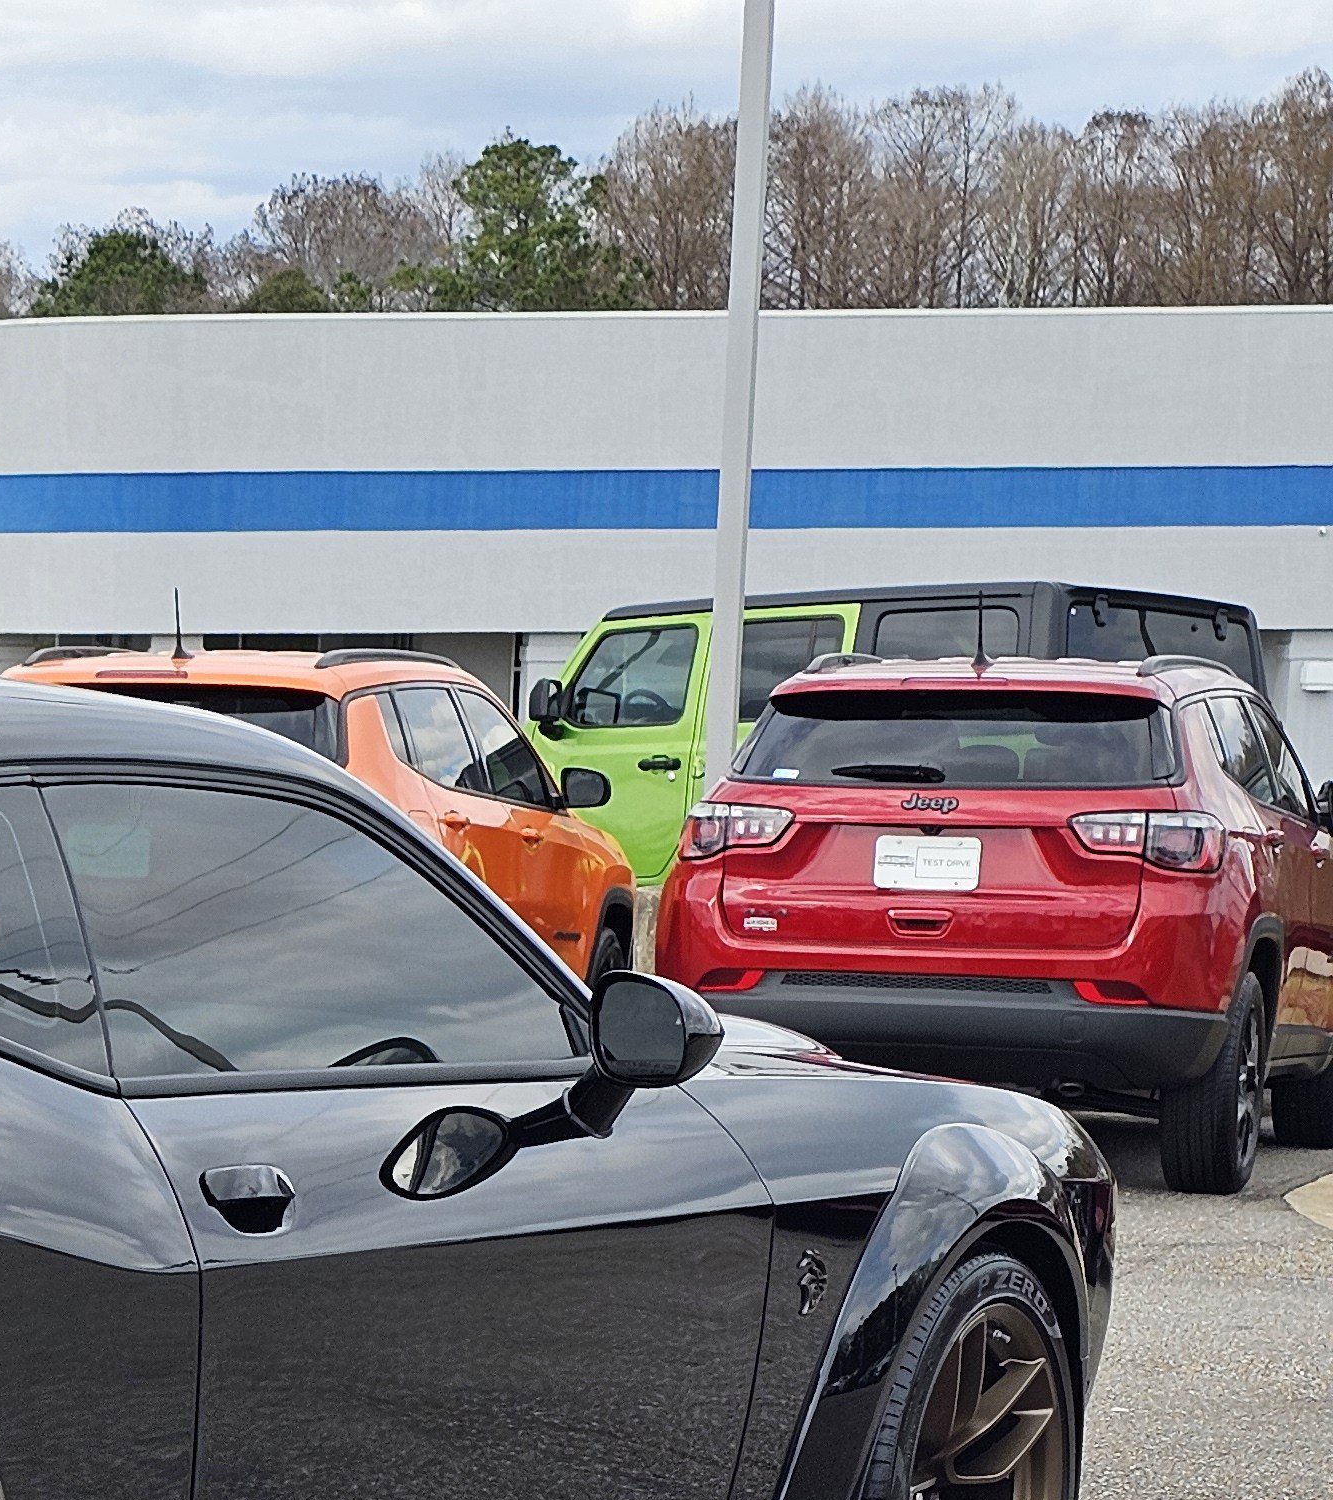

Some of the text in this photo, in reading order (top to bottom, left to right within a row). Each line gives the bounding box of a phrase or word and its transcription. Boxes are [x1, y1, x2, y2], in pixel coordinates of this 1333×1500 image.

[900, 793, 960, 815] Jeep
[922, 858, 944, 867] TEST
[946, 858, 971, 868] DRIVE
[993, 1269, 1048, 1315] ZERO
